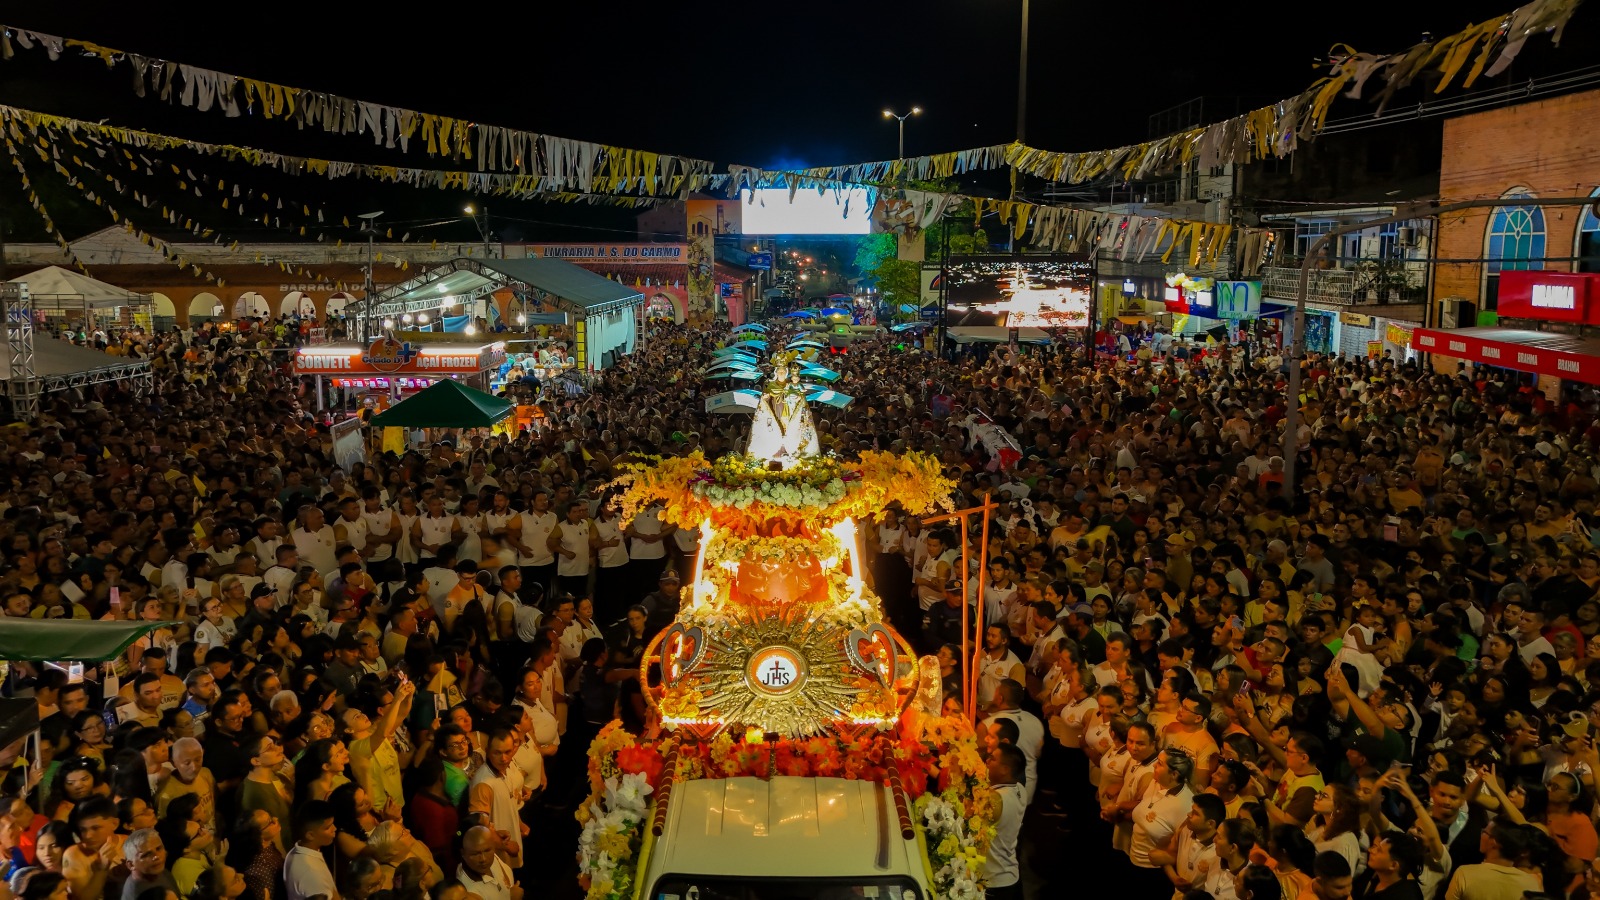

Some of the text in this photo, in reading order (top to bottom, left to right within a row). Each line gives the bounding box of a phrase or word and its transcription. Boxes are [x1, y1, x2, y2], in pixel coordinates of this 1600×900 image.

[543, 246, 681, 258] LIVRARIA N. S. DO CARMO
[1482, 347, 1500, 358] BRAHMA
[296, 355, 351, 369] SORVETE
[362, 356, 391, 364] Gelado
[416, 355, 440, 370] AÇAÍ
[441, 356, 477, 368] FROZEN
[1517, 353, 1537, 365] BRAHMA
[1558, 359, 1579, 372] BRAHMA
